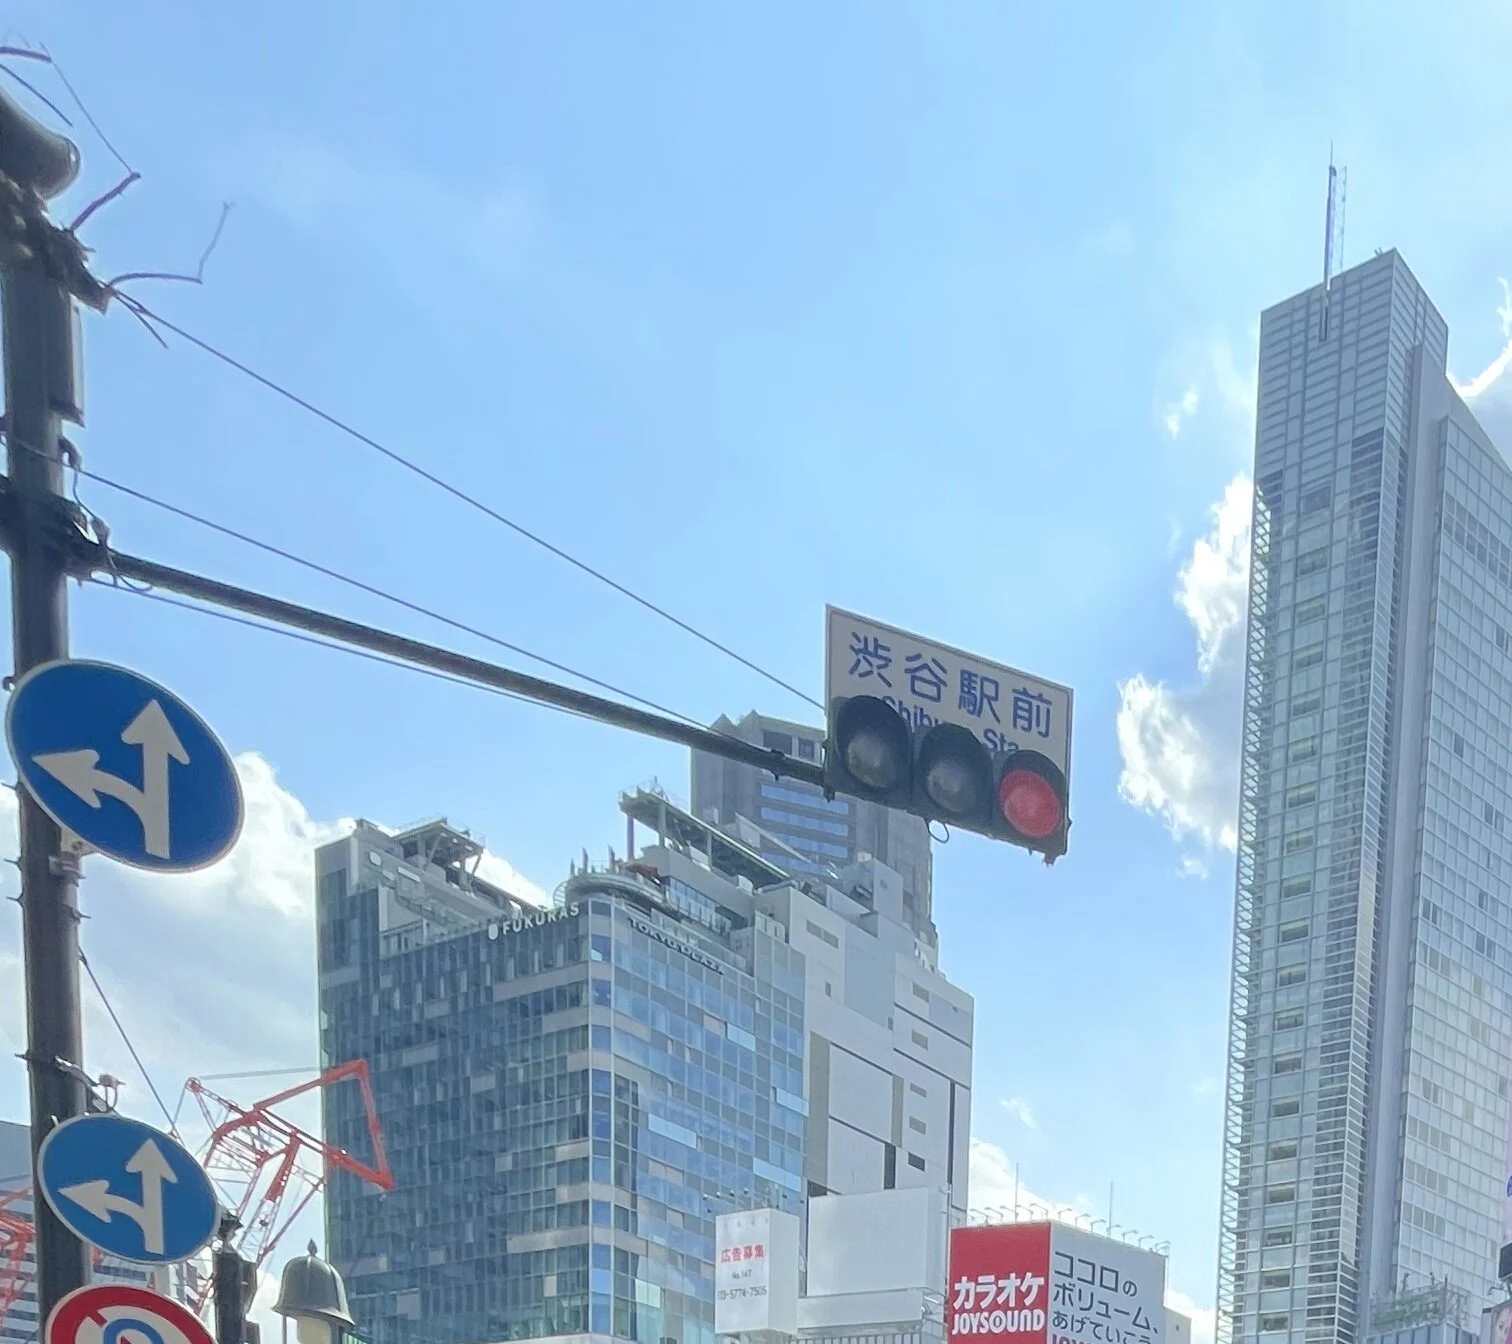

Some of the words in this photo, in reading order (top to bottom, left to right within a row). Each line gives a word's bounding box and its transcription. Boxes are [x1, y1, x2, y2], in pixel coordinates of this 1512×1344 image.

[848, 630, 1053, 739] 渋谷駅前
[953, 1272, 1045, 1310] カラオケ
[1054, 1251, 1138, 1297] ココロの
[951, 1308, 1045, 1336] JOYSOUND
